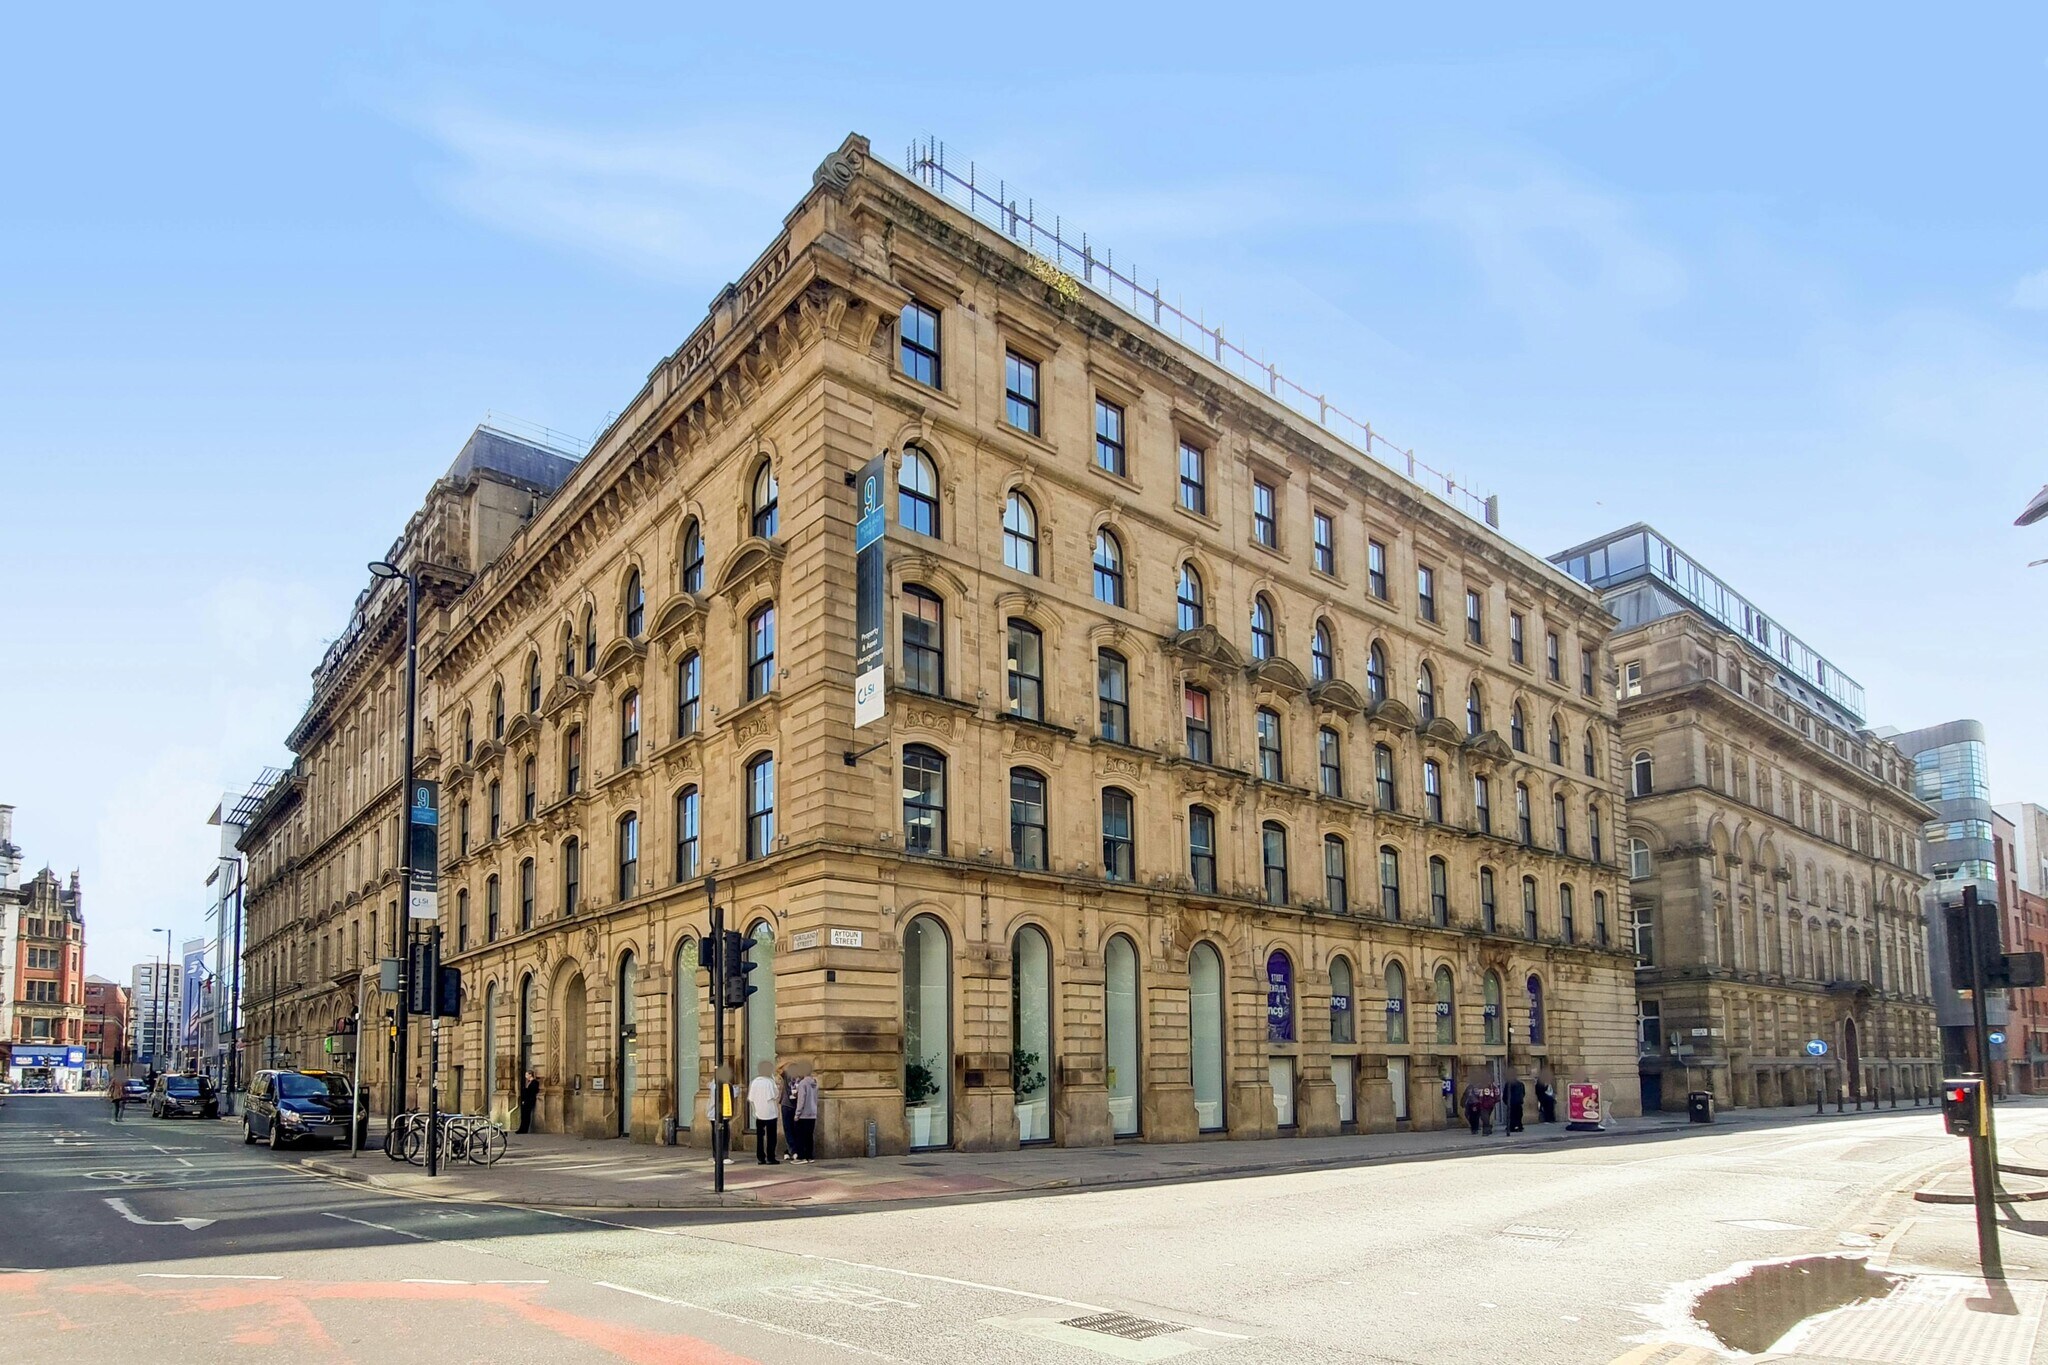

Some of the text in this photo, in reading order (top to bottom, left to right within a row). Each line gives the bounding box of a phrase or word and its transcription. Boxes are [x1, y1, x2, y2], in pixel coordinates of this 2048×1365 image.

[864, 475, 876, 517] 9
[861, 628, 879, 642] Property
[417, 787, 430, 808] 9
[834, 930, 858, 938] AYTOUN
[1330, 996, 1346, 1009] ncg
[1385, 1000, 1400, 1012] ncg
[1435, 1003, 1448, 1014] ncg
[1268, 1005, 1284, 1018] ncg
[1483, 1005, 1496, 1016] ncg
